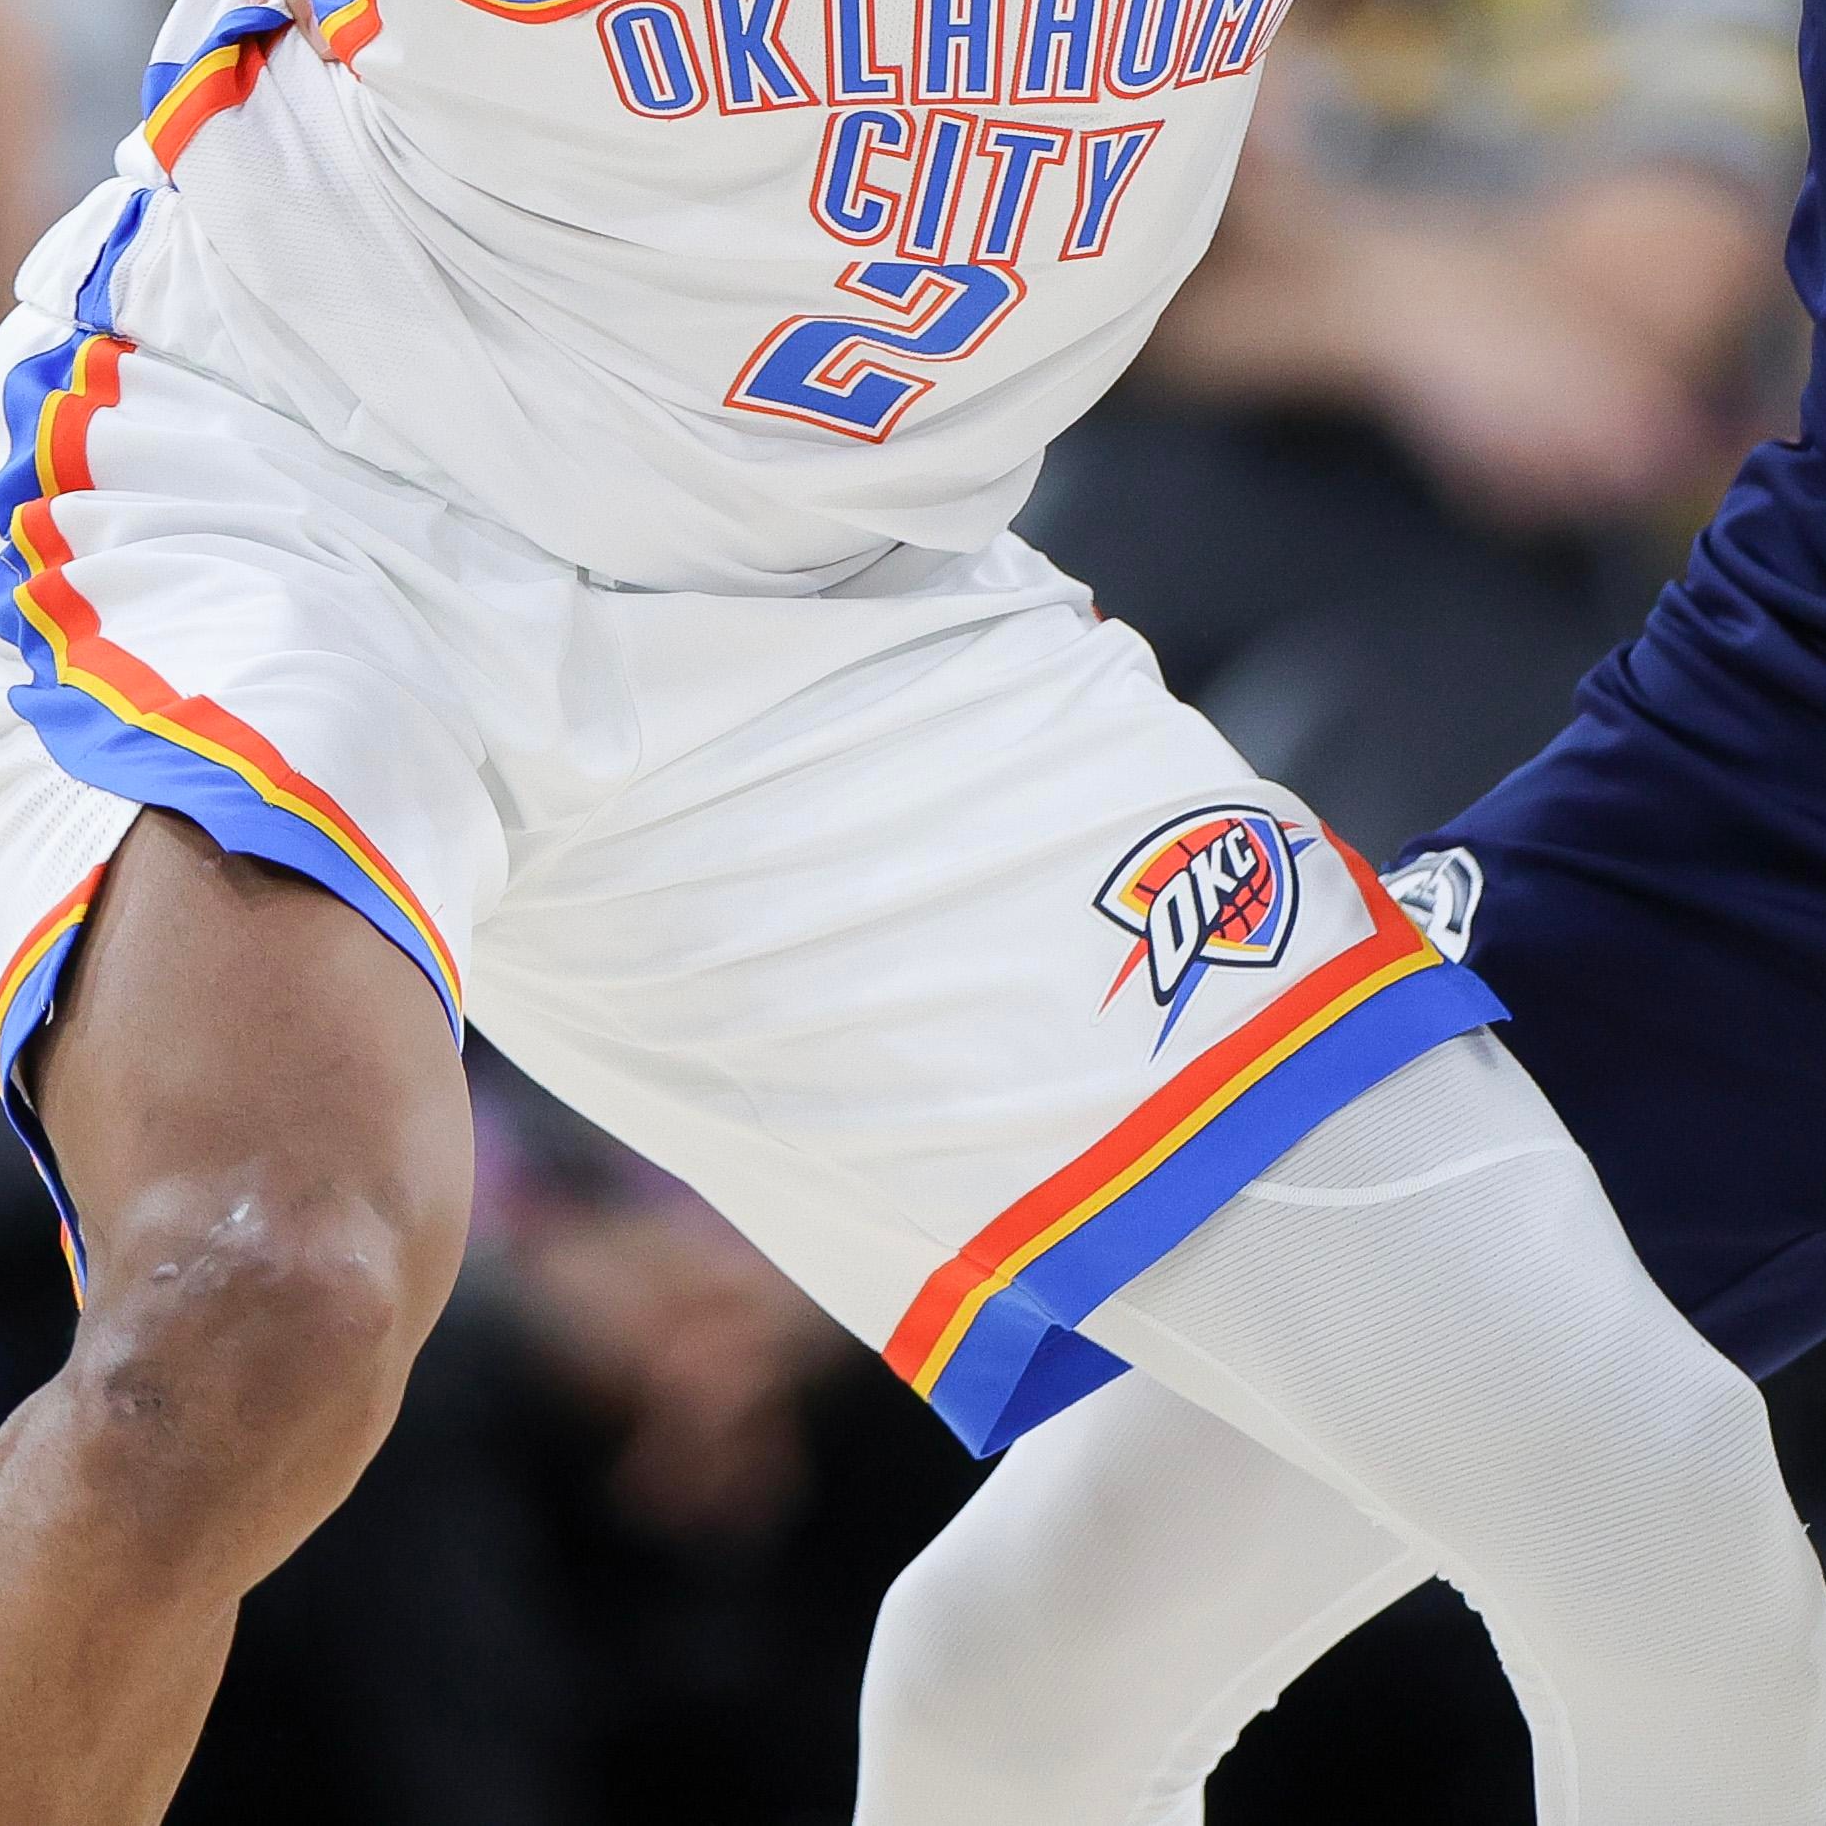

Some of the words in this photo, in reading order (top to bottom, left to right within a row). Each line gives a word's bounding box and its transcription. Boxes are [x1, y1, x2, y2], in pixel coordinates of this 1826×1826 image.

[809, 108, 1165, 267] CITY
[722, 263, 1028, 445] 2
[1149, 824, 1260, 1006] OKC
